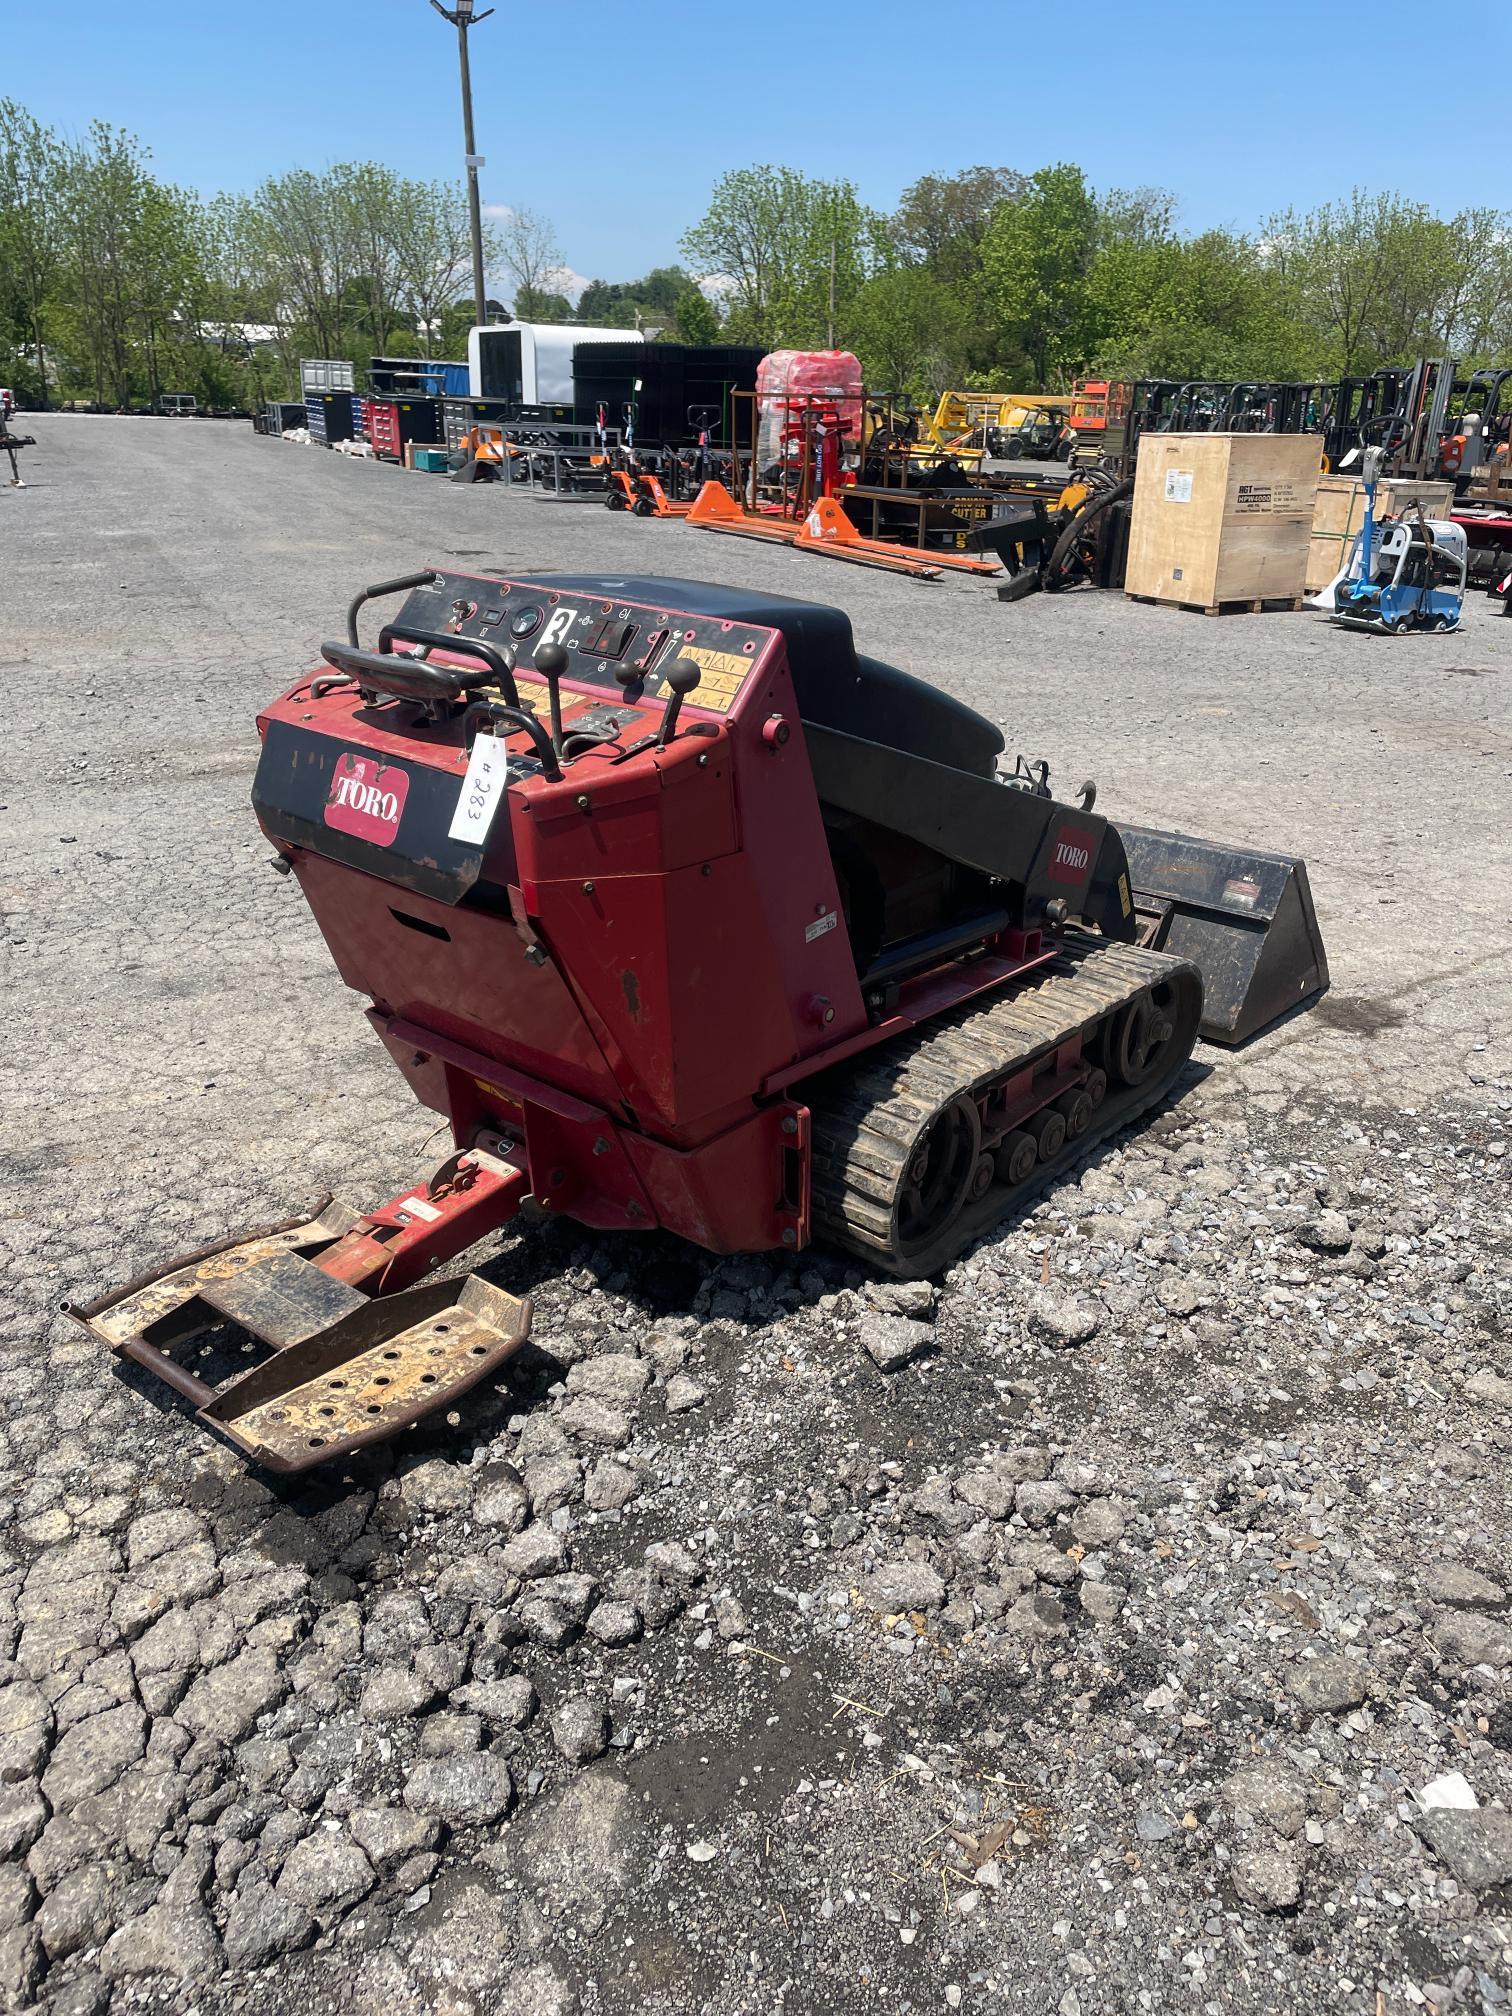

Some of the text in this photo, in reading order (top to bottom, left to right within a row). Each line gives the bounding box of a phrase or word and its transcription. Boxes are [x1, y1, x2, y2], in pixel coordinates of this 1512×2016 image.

[951, 507, 987, 519] CUTER
[336, 776, 398, 821] TORO
[1055, 842, 1089, 869] TORO
